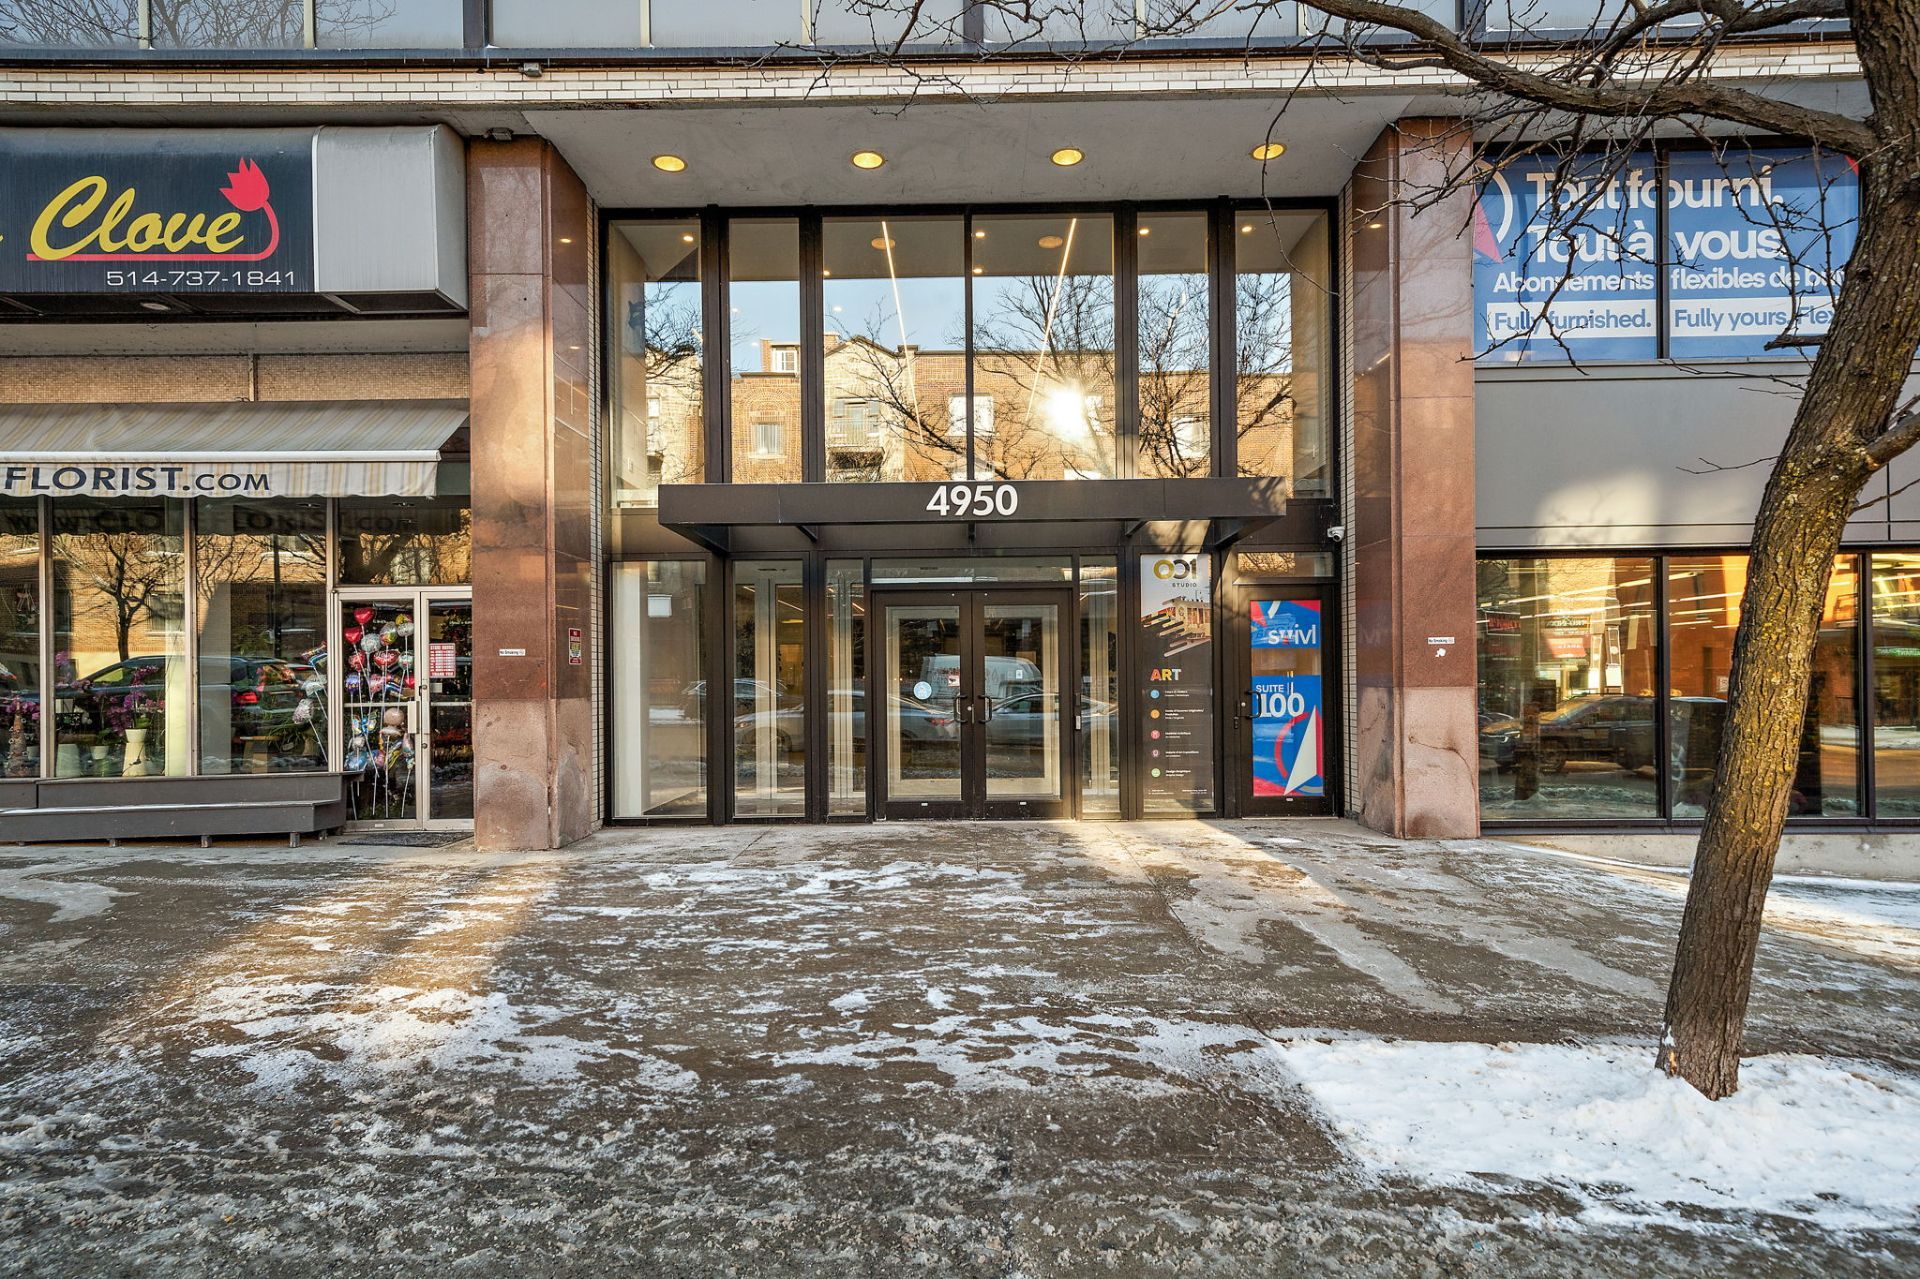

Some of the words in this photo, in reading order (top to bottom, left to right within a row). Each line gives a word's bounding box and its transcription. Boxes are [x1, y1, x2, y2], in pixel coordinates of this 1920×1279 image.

[30, 175, 245, 260] Clove
[1627, 219, 1655, 262] à
[106, 270, 296, 286] 514-737-1841
[1493, 270, 1655, 293] Abonnements
[1670, 266, 1766, 290] flexibles
[1769, 265, 1800, 288] de
[1495, 310, 1543, 335] Fully
[1550, 308, 1652, 331] furnished.
[1674, 307, 1724, 332] Fully
[926, 484, 1018, 516] 4950
[1150, 668, 1182, 681] ART
[1255, 684, 1285, 693] SUITE
[1256, 692, 1305, 718] 100
